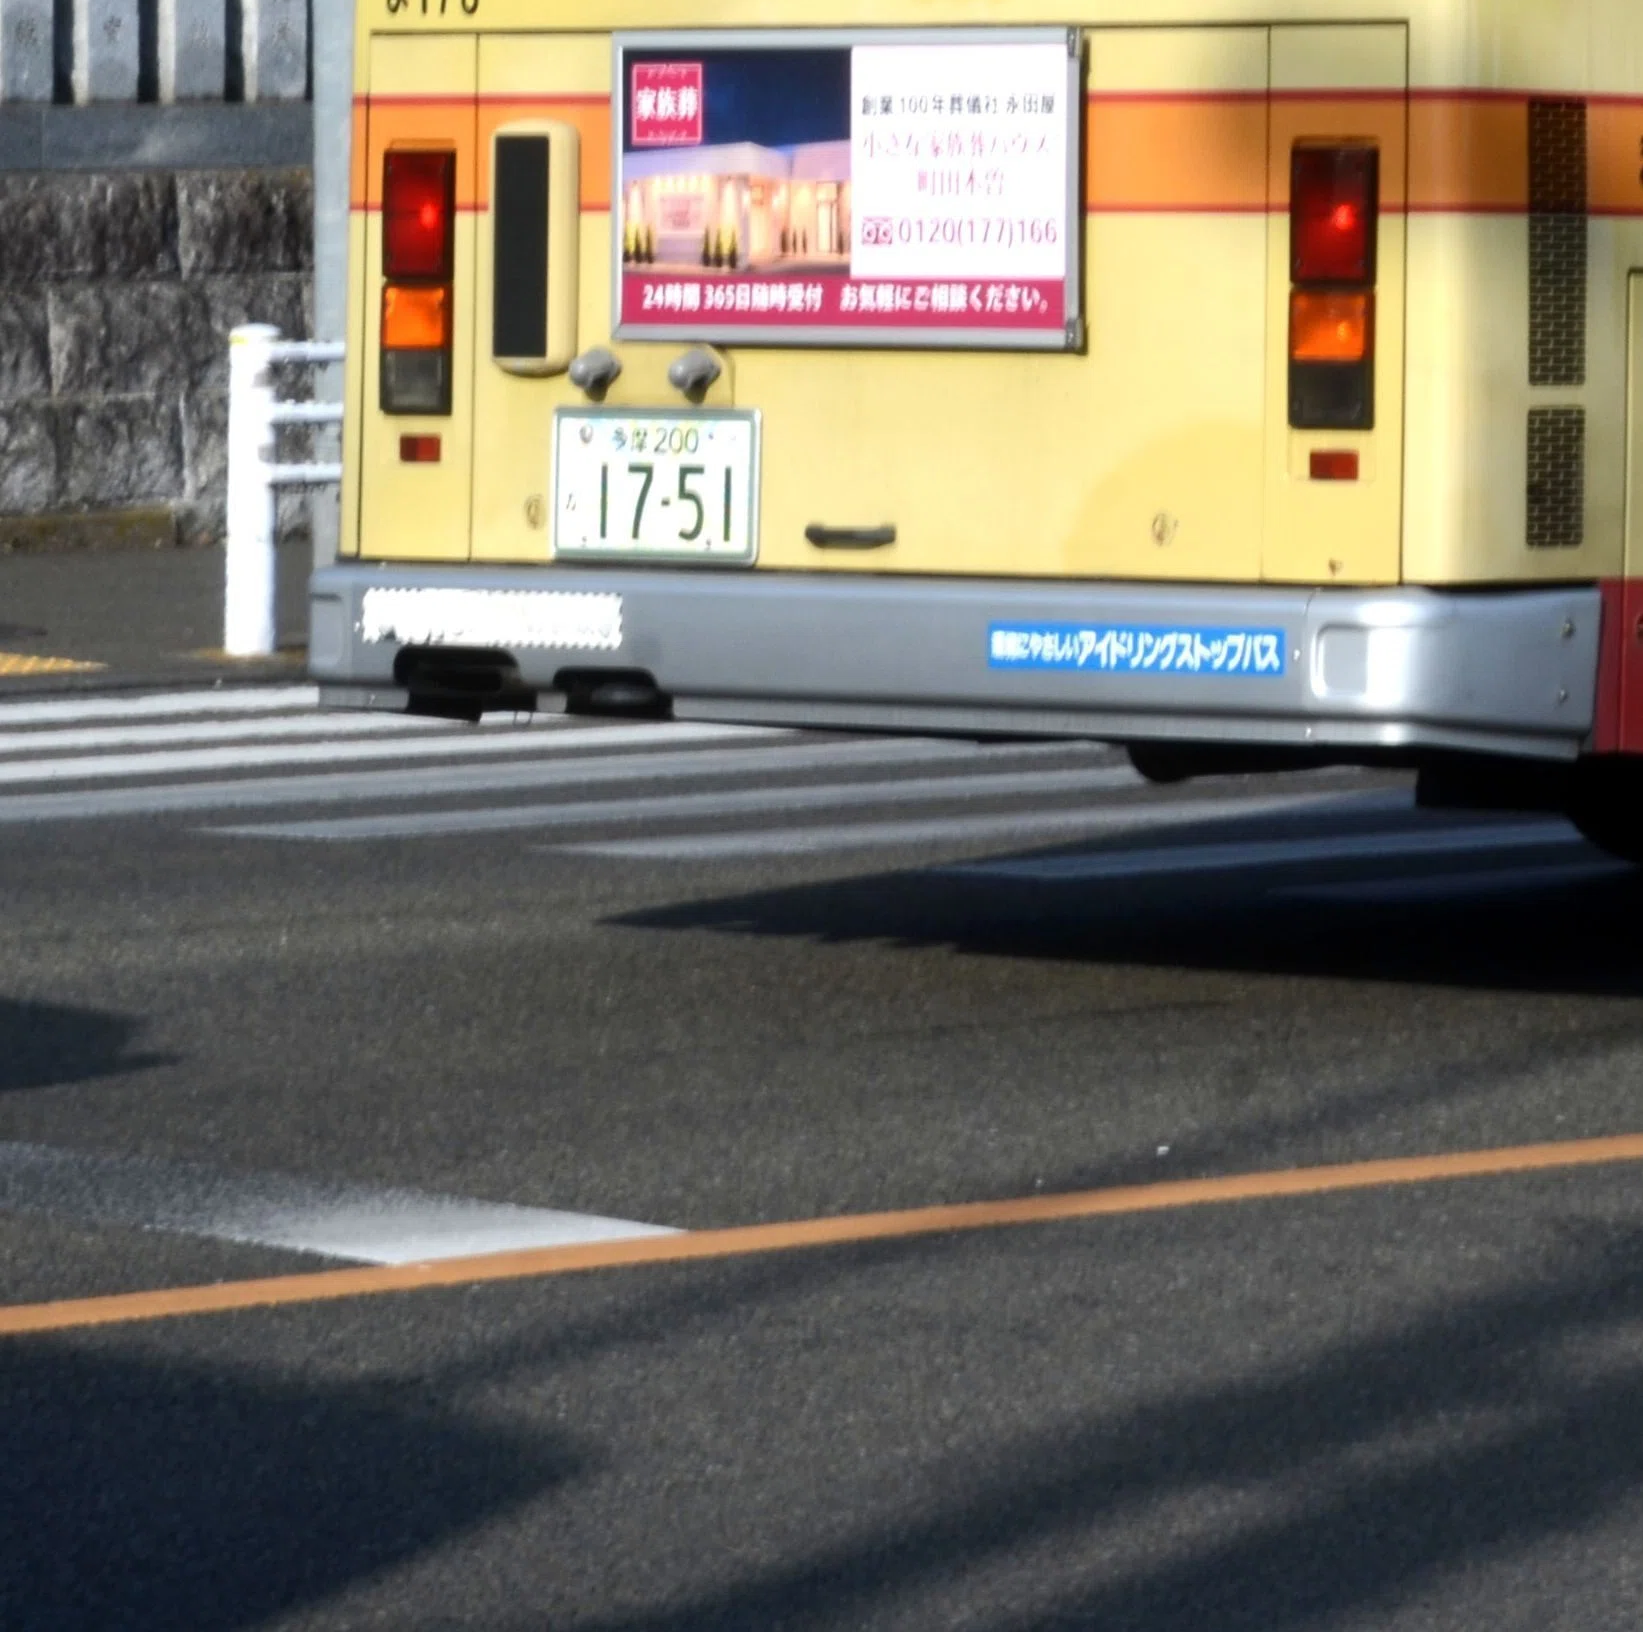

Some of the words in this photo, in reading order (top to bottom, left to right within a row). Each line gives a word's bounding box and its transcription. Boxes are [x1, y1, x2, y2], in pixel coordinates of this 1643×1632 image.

[635, 85, 700, 122] 家族葬
[898, 217, 1057, 248] 0120(177)166
[599, 463, 733, 543] 17-51
